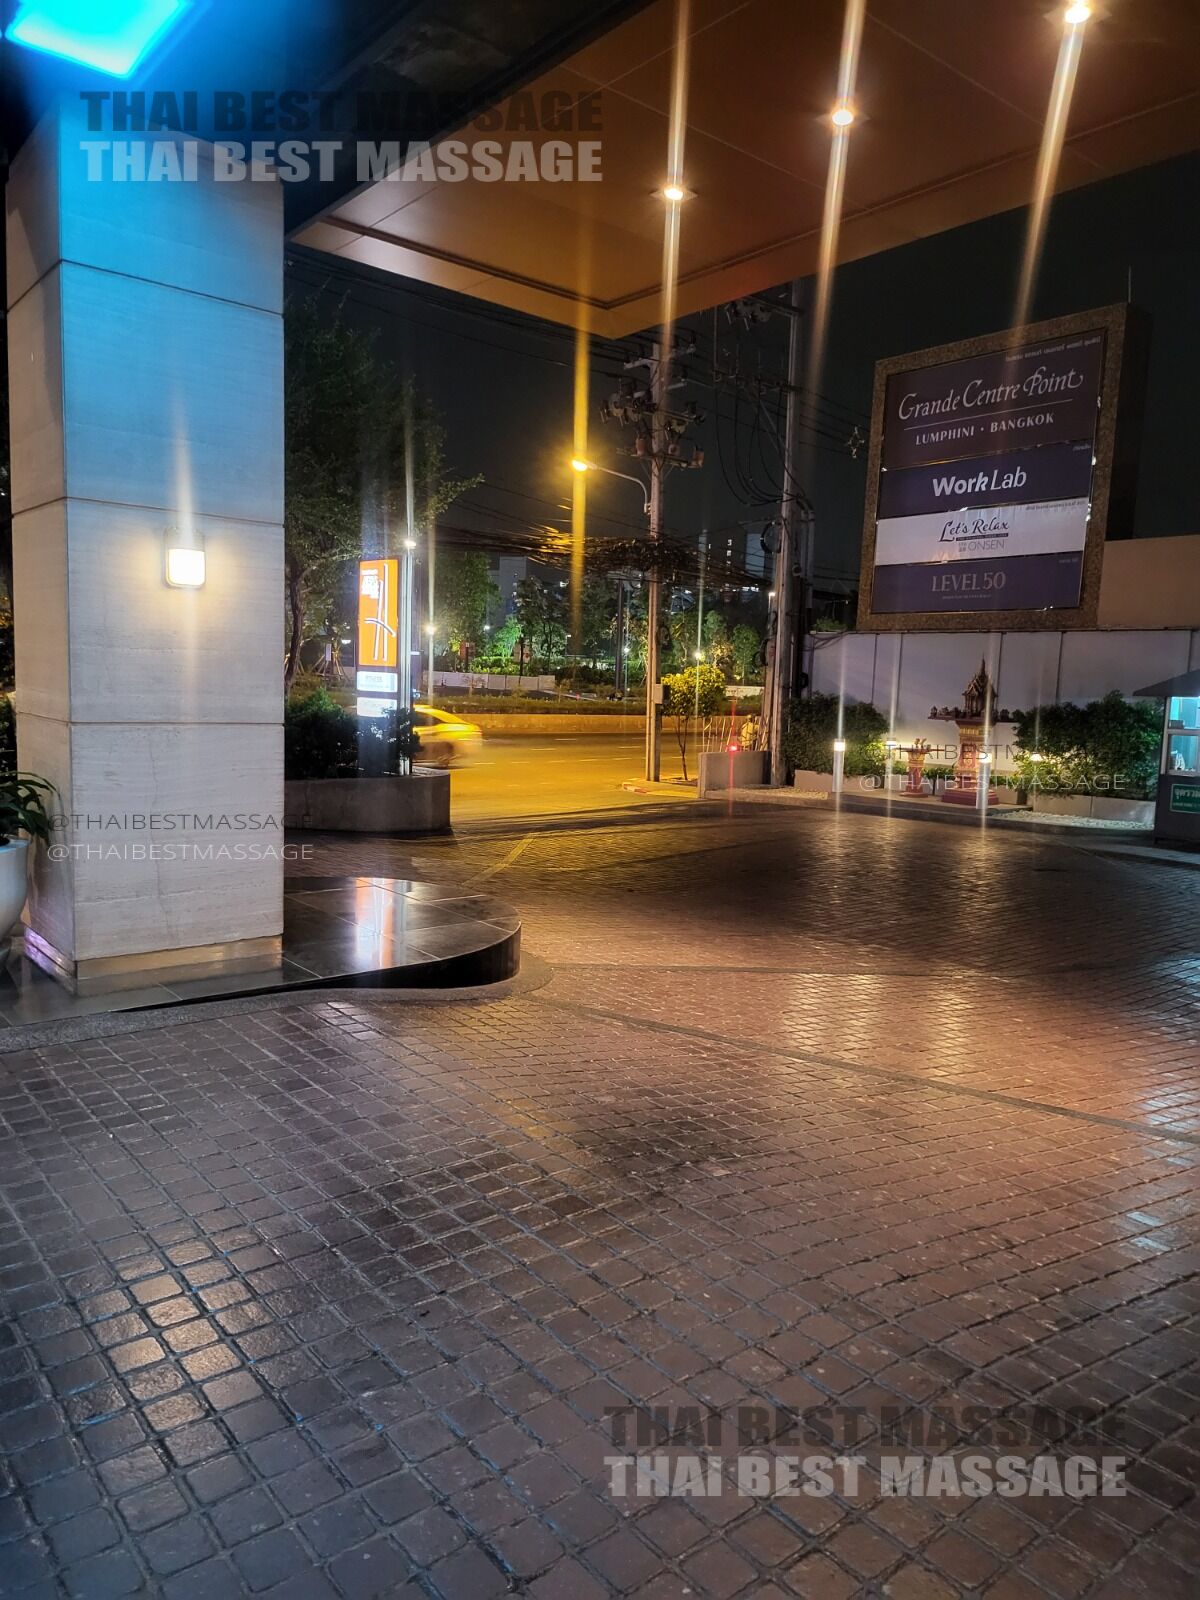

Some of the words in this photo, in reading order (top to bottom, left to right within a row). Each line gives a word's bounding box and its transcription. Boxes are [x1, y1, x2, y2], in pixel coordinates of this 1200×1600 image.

[898, 389, 960, 420] Grande
[962, 379, 1021, 408] Centre
[1022, 366, 1084, 397] Point
[915, 425, 975, 446] LUMPHINI
[990, 412, 1055, 433] BANGKOK
[938, 520, 968, 543] Let's
[972, 517, 1009, 534] Relax
[968, 540, 1005, 552] ONSEN
[932, 573, 980, 592] LEVEL
[983, 571, 1006, 590] 50
